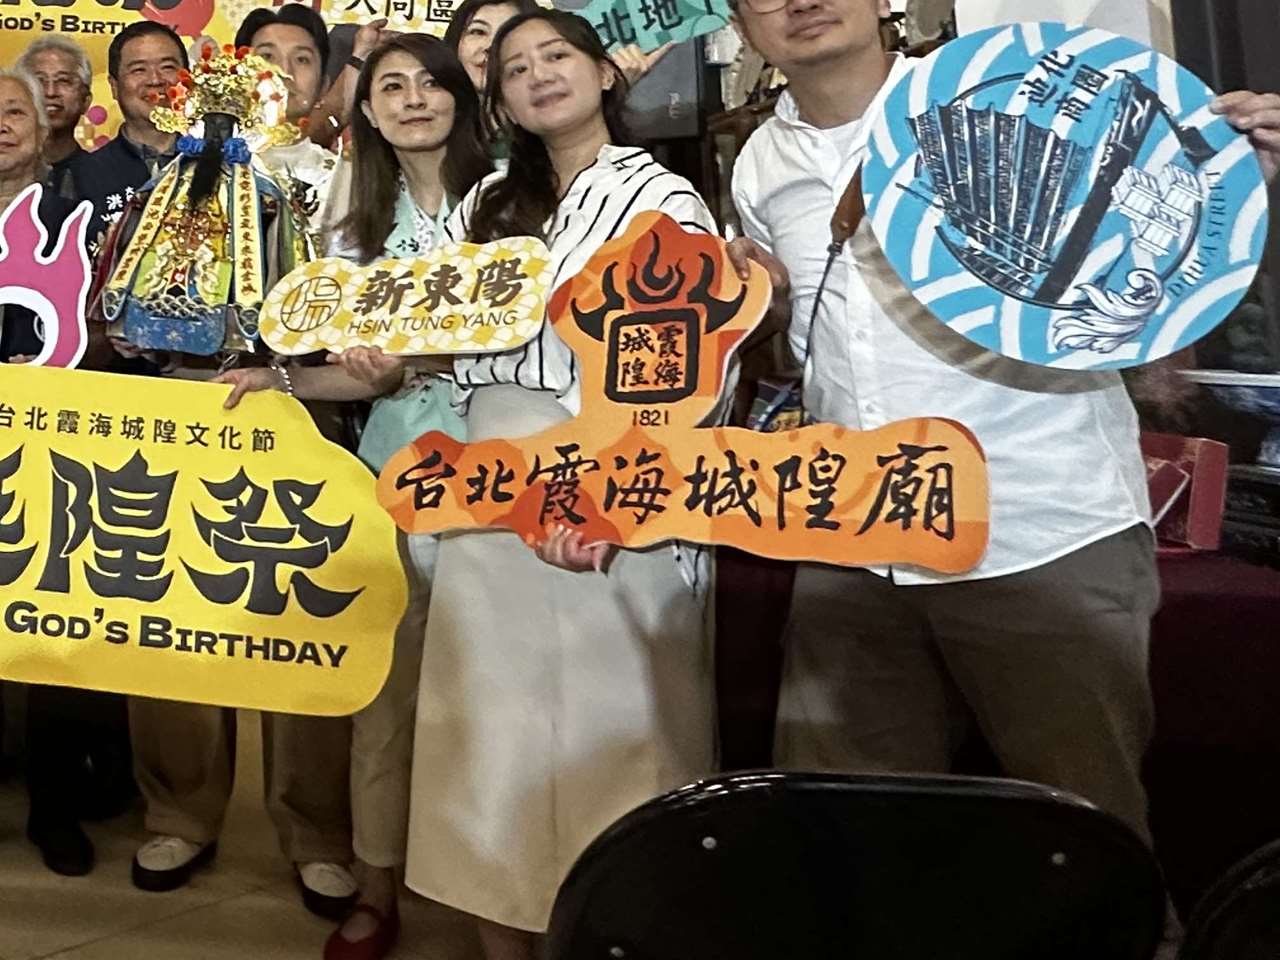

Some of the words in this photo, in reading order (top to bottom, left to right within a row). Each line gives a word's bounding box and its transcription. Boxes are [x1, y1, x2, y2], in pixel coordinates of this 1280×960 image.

[1018, 50, 1075, 107] 迪化
[1056, 64, 1109, 123] 商圈
[1171, 244, 1218, 297] DIHUA
[1205, 171, 1226, 240] STREET
[353, 257, 528, 316] 新東陽
[348, 318, 392, 335] HSIN
[401, 313, 455, 331] TUNG
[461, 309, 518, 327] YANG
[632, 409, 669, 426] 1821
[395, 442, 953, 541] 台北霞海城隍廟
[5, 600, 129, 645] GOD'S
[139, 615, 348, 668] BIRTHDAY
